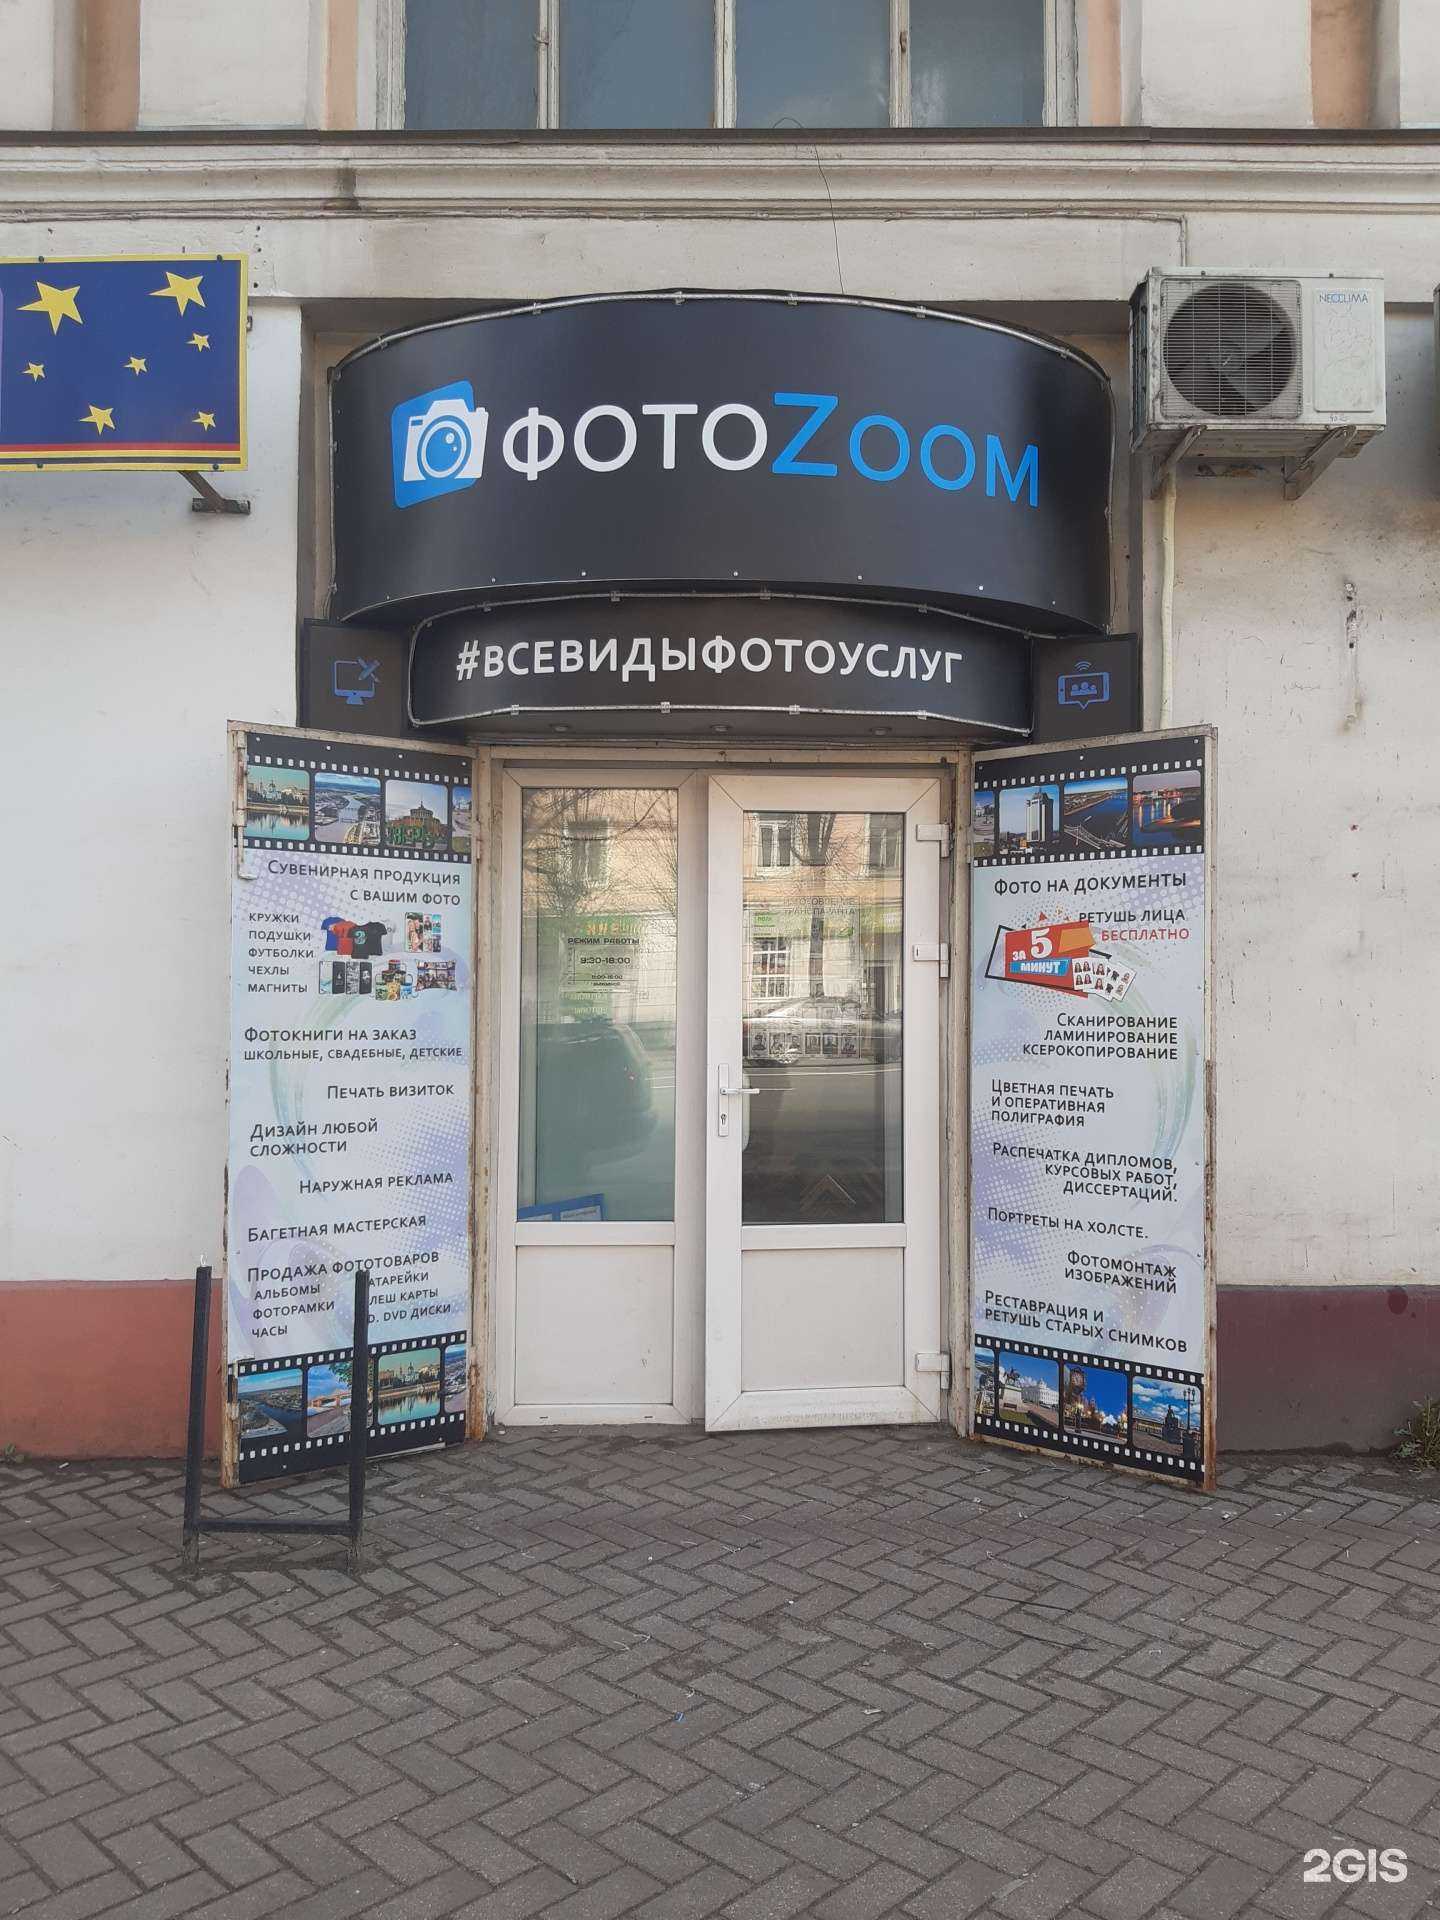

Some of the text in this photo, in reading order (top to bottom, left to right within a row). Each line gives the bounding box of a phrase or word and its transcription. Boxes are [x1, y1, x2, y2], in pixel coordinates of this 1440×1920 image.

[456, 635, 963, 684] #ВСЕВИДЫФОТОУСЛУГ
[268, 860, 461, 886] СУВЕНИРНАЯ ПРОДУКЦИЯ
[994, 872, 1187, 895] ФОТО НА ДОКУМЕНТЫ
[350, 889, 461, 906] С ВАШИМ ФОТО
[249, 912, 299, 923] КРУЖКИ
[1079, 909, 1186, 924] РЕТУШЬ ЛИЦА
[249, 930, 311, 942] ПОДУШКИ
[567, 937, 640, 945] РЕЖИМ РАБОТЫ
[1030, 928, 1053, 959] 5
[1101, 928, 1190, 942] БЕСПЛАТНО
[248, 948, 314, 959] ФУТБОЛКИ
[248, 965, 289, 976] ЧЕХЛЫ
[1021, 959, 1061, 974] МИНУТ
[248, 983, 308, 993] МАГНИТЫ
[1057, 1012, 1178, 1029] СКАНИРОВАНИЕ
[244, 1027, 417, 1042] ФОТОКНИГИ НА ЗАКАЗ
[1044, 1029, 1178, 1044] ЛАМИНИРОВАНИЕ
[244, 1047, 462, 1062] ШКОЛЬНЫЕ, СВАДЕБНЫЕ, ДЕТСКИЕ
[1023, 1044, 1178, 1060] КСЕРОКОПИРОВАНИЕ
[327, 1084, 455, 1099] ПЕЧАТЬ ВИЗИТОК
[992, 1078, 1114, 1098] ЦВЕТНАЯ ПЕЧАТЬ
[991, 1096, 1106, 1113] И ОПЕРАТИВНАЯ
[991, 1110, 1085, 1127] ПОЛИГРАФИЯ
[250, 1118, 378, 1142] ДИЗАЙН ЛЮБОЙ
[250, 1140, 347, 1157] СЛОЖНОСТИ
[993, 1142, 1178, 1174] РАСПЕЧАТКА ДИПЛОМОВ,
[299, 1172, 454, 1194] НАРУЖНАЯ РЕКЛАМА
[1045, 1164, 1178, 1190] КУРСОВЫХ РАБОТ,
[1063, 1180, 1178, 1203] ДИССЕРТАЦИЙ.
[248, 1215, 427, 1242] БАГЕТНАЯ МАСТЕРСКАЯ
[988, 1207, 1149, 1240] ПОРТРЕТЫ НА ХОЛСТЕ.
[247, 1251, 440, 1283] ПРОДАЖА ФОТОТОВАРОВ
[1067, 1249, 1177, 1278] ФОТОМОНТАЖ
[368, 1271, 430, 1288] АТАРЕЙКИ
[1064, 1267, 1177, 1294] ИЗОБРАЖЕНИЙ
[254, 1284, 321, 1301] АЛЬБОМЫ
[367, 1287, 439, 1306] ЛЕШ КАРТЫ
[253, 1301, 335, 1320] ФОТОРАМКИ
[383, 1309, 407, 1322] DVD
[410, 1303, 451, 1321] ДИСКИ
[985, 1289, 1104, 1323] РЕСТАВРАЦИЯ И
[252, 1324, 288, 1339] ЧАСЫ
[985, 1307, 1188, 1353] РЕТУШЬ СТАРЫХ СНИМКОВ
